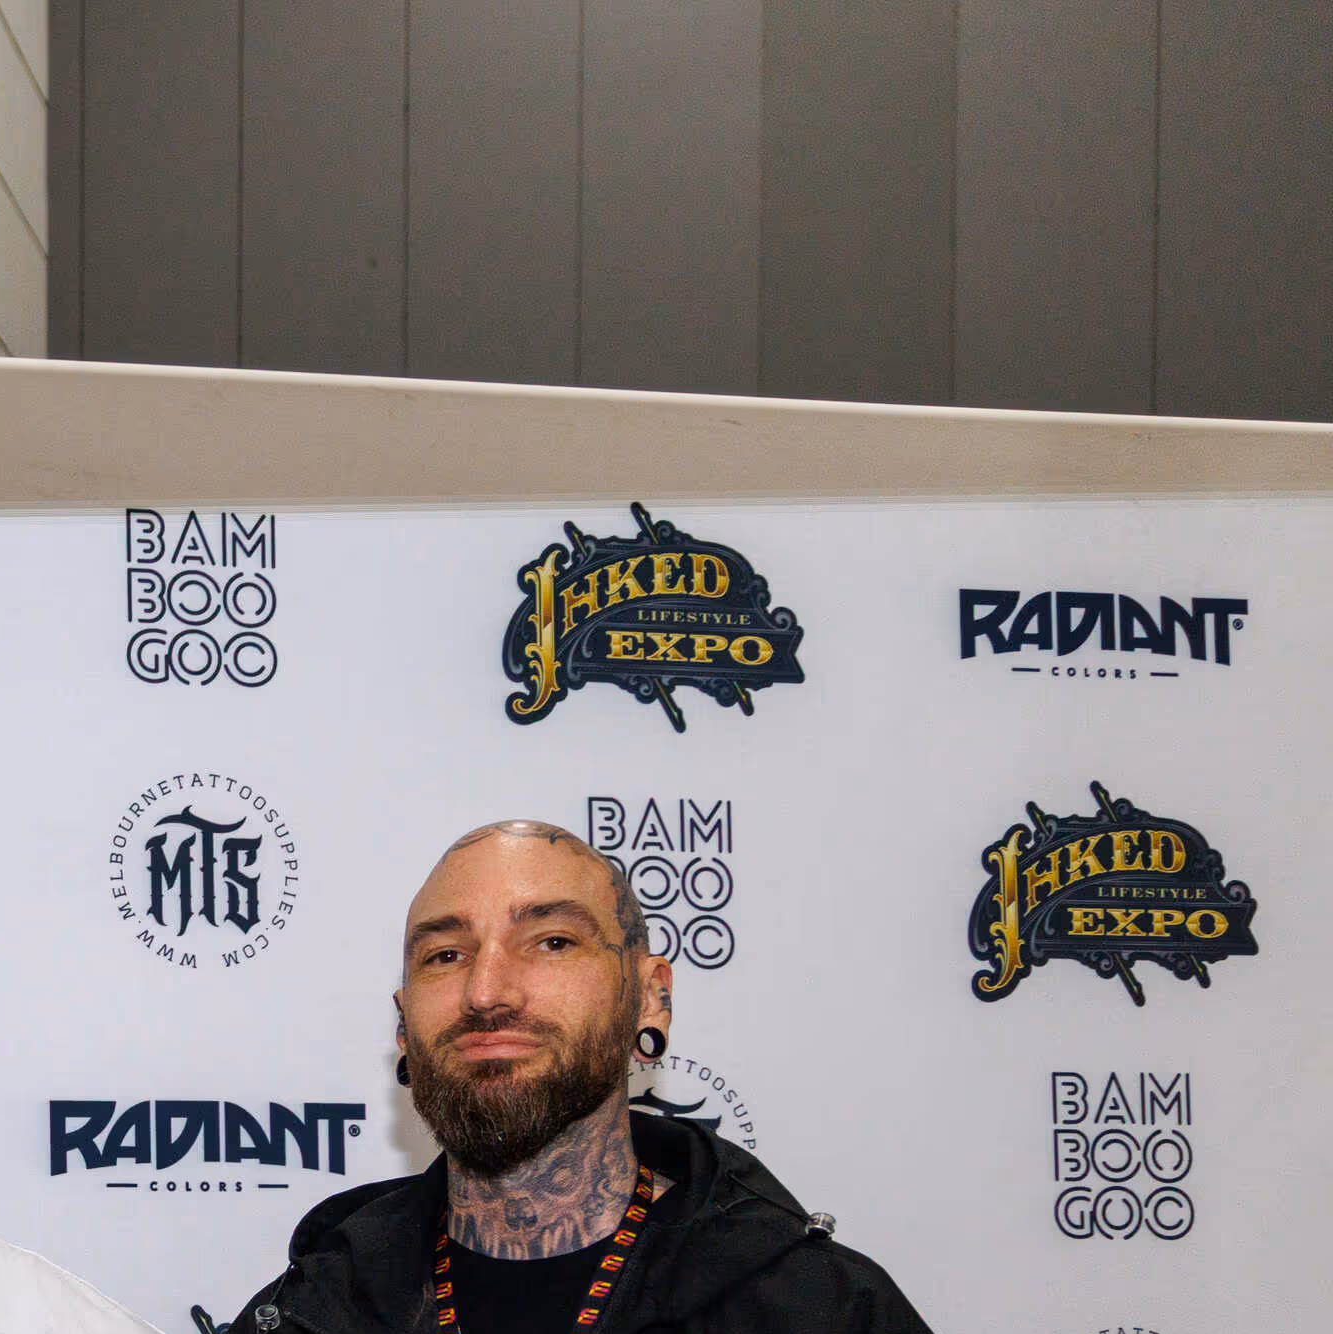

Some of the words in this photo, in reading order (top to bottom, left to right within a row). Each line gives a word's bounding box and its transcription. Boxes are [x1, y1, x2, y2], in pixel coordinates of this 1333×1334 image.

[127, 509, 276, 569] BAM
[127, 569, 276, 628] BOO
[637, 610, 752, 625] LIFESTYLE
[607, 631, 774, 667] EXPO
[1052, 667, 1136, 679] COLORS
[588, 797, 731, 853] BAM
[145, 806, 262, 936] MTS
[603, 855, 733, 912] OO
[1098, 887, 1207, 899] LIFESTYLE
[1068, 907, 1229, 938] EXPO
[1052, 1072, 1191, 1126] BAM
[1054, 1129, 1193, 1182] BOO
[150, 1182, 242, 1192] COLORS
